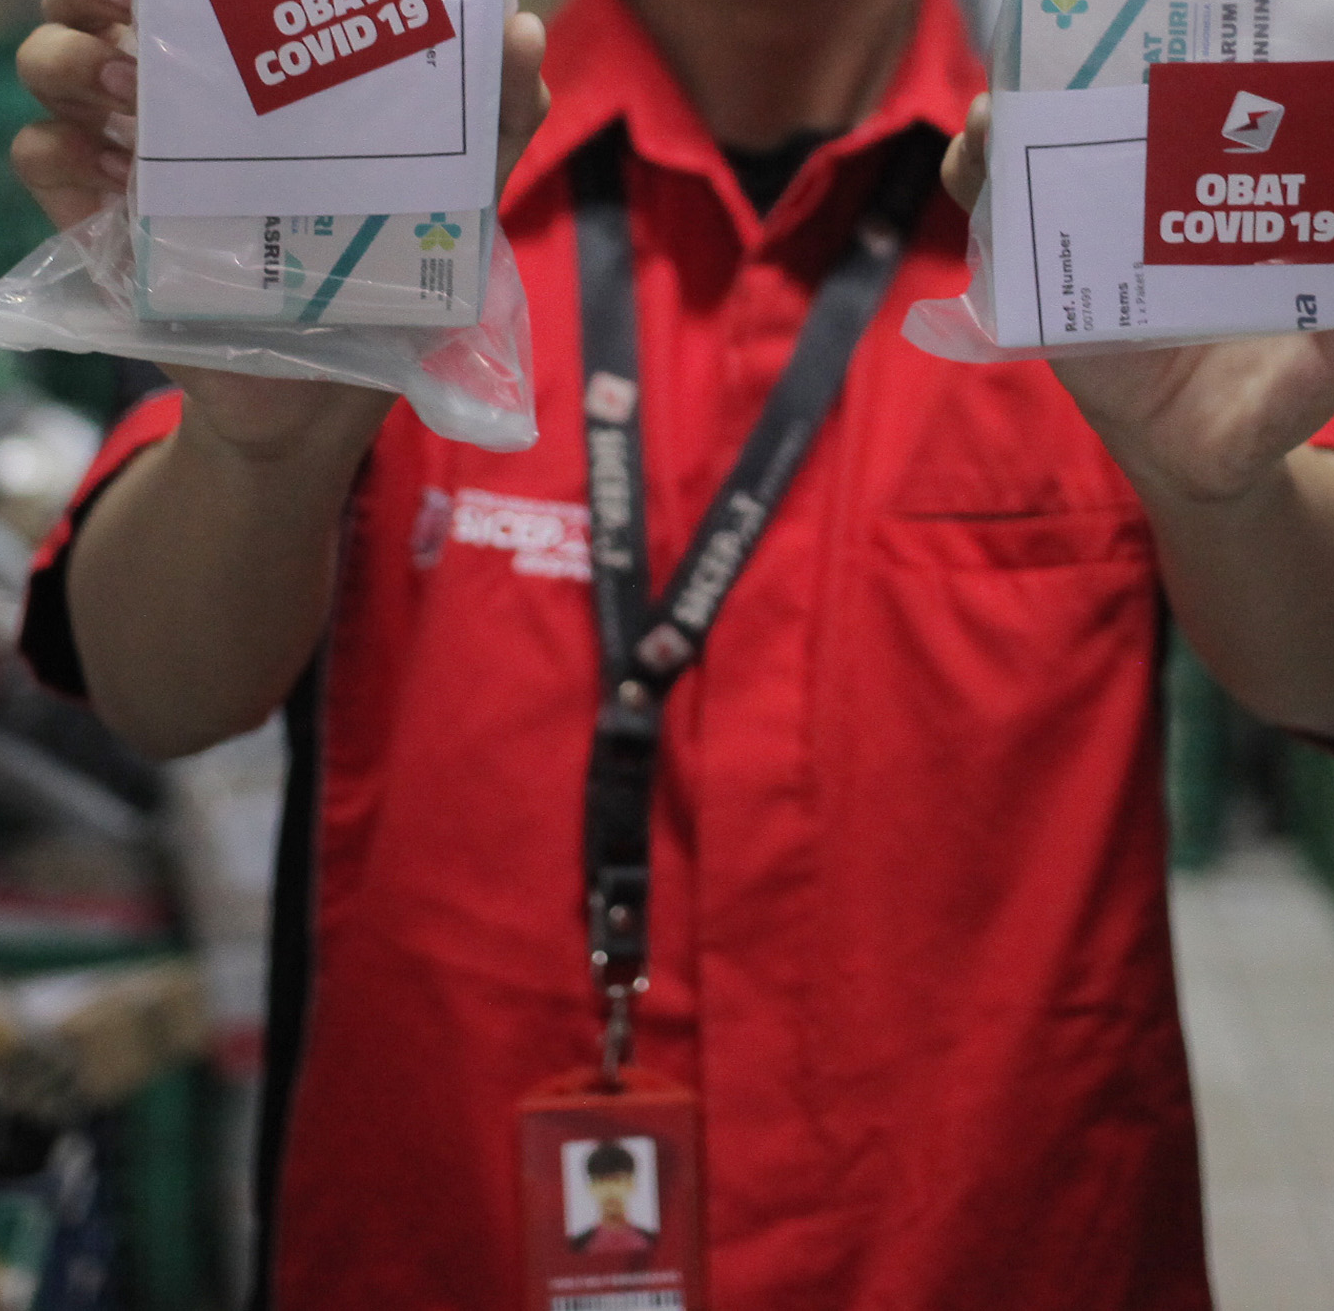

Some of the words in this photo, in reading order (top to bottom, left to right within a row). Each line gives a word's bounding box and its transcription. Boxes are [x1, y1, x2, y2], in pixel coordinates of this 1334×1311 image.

[255, 15, 378, 86] COVID
[1196, 173, 1306, 207] OBAT
[1160, 210, 1285, 244] COVID
[1059, 231, 1074, 295] Number
[1063, 300, 1077, 332] Ref.
[1118, 282, 1131, 327] Items
